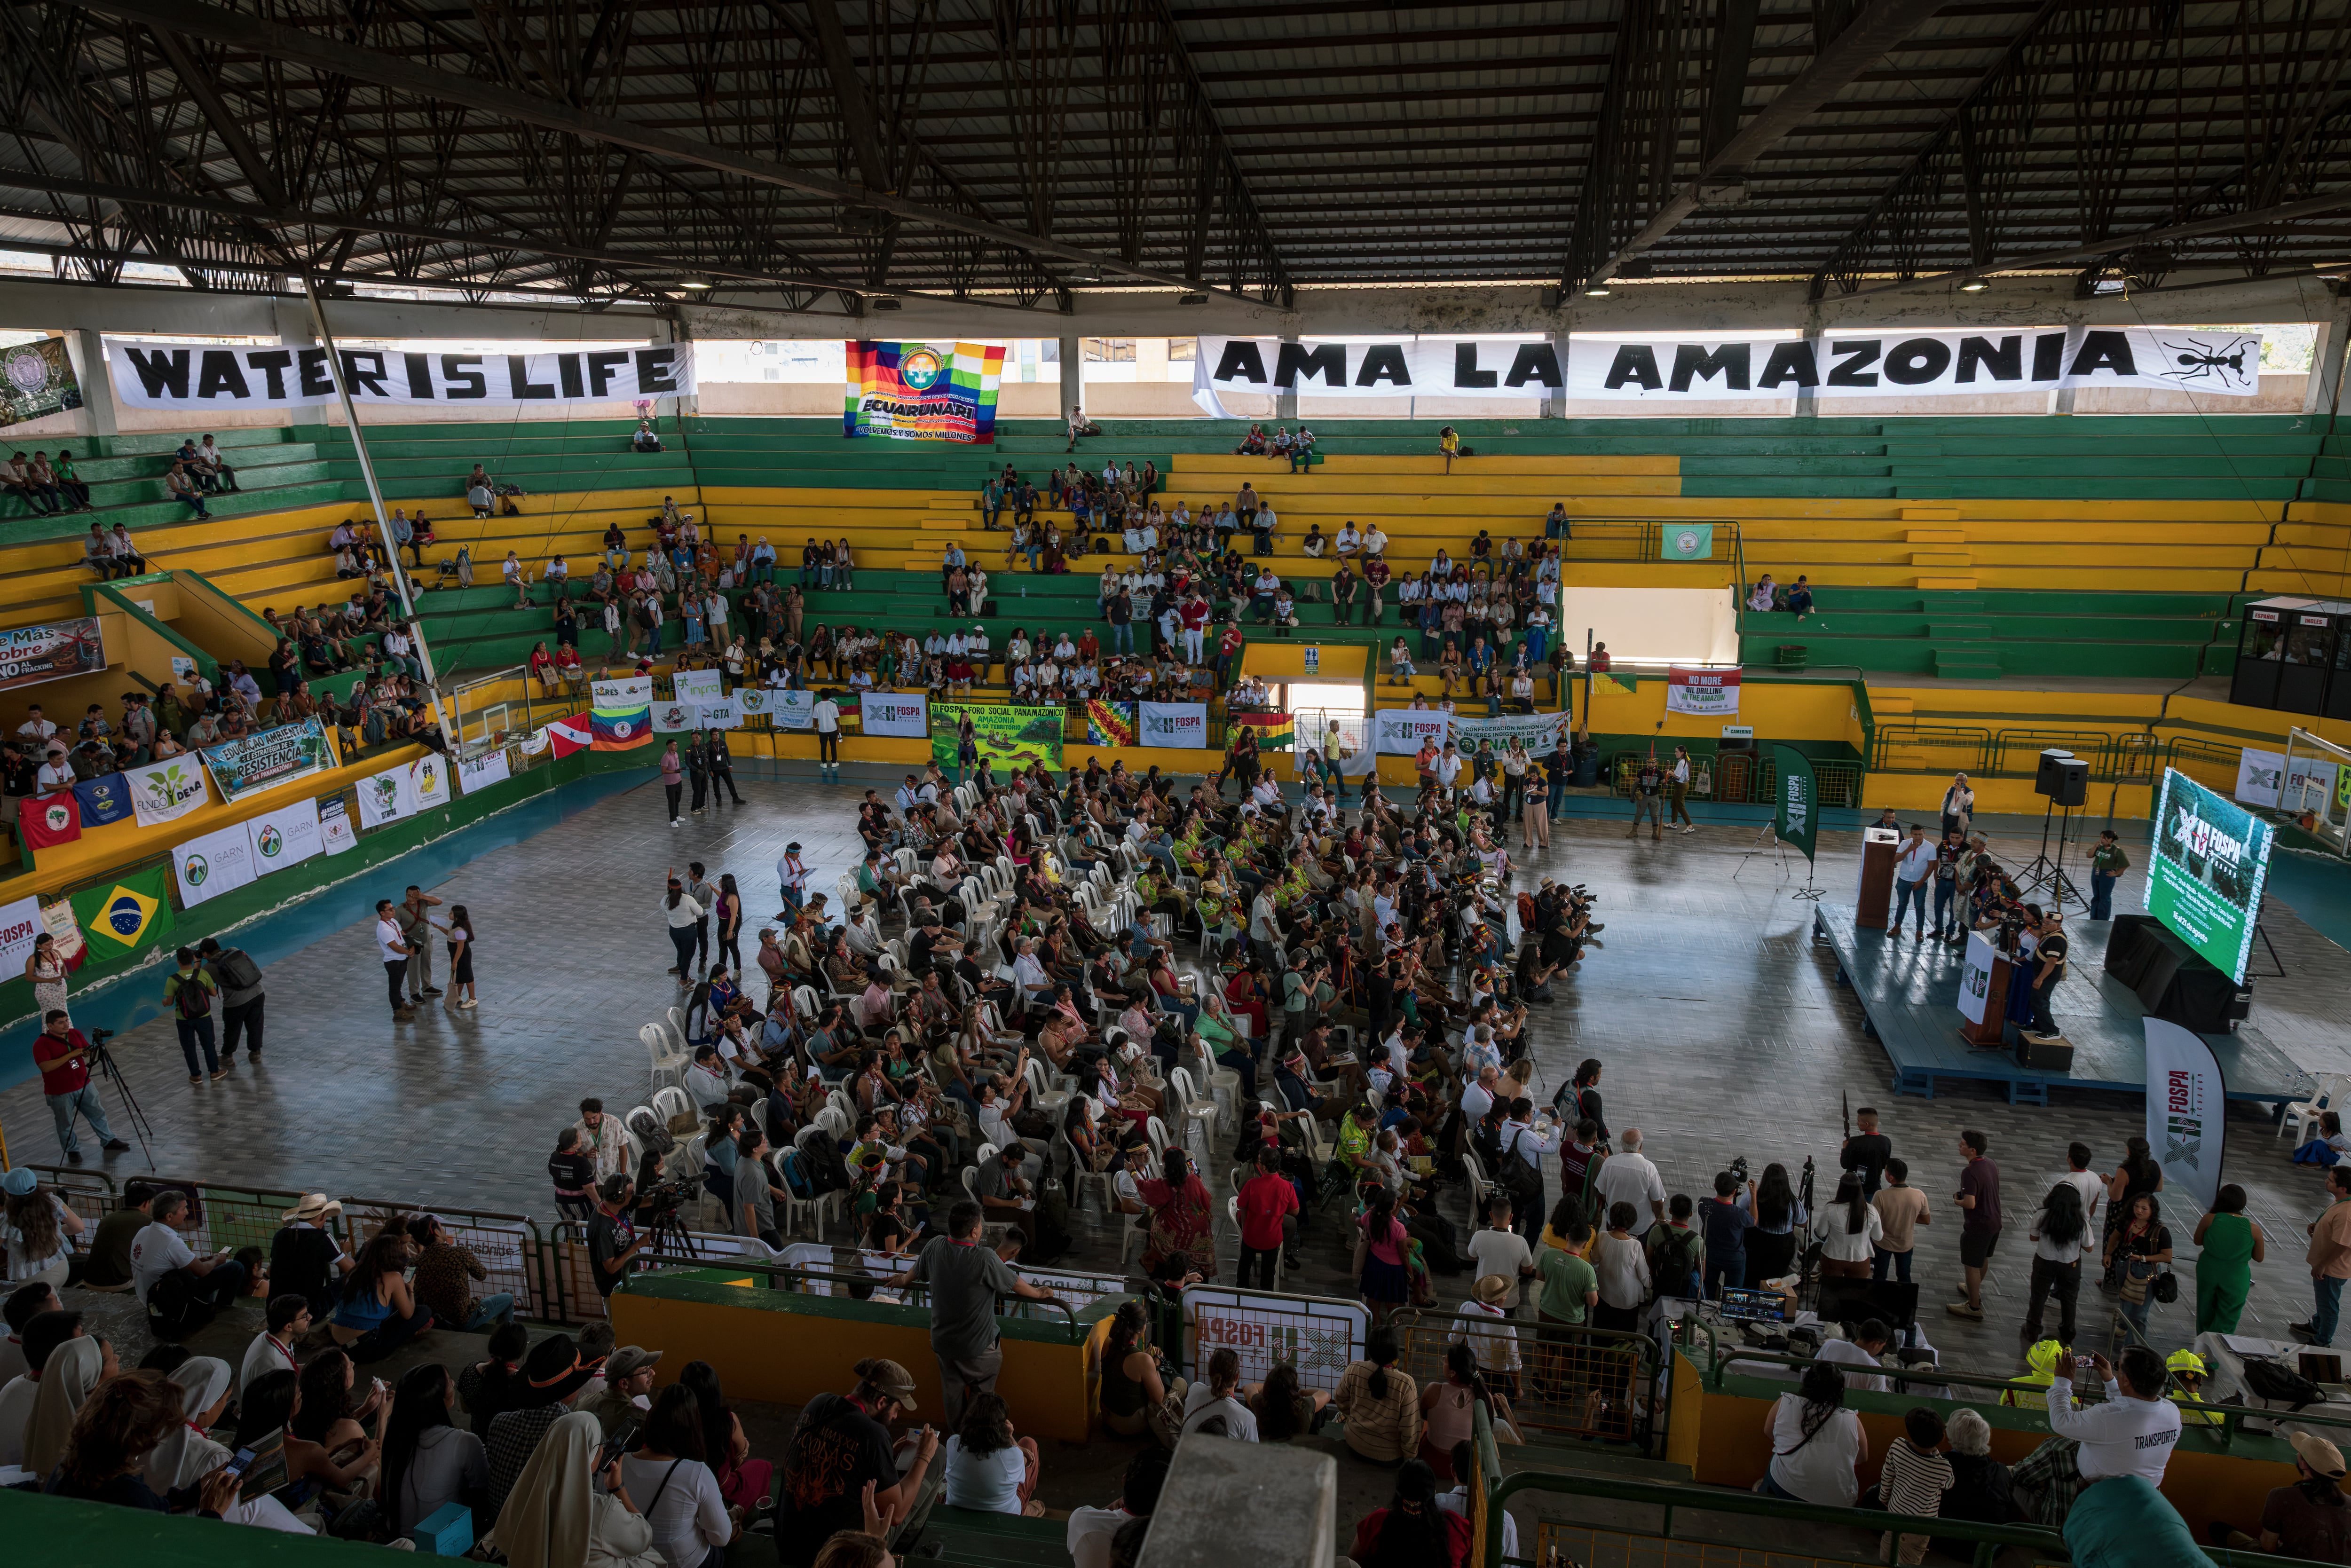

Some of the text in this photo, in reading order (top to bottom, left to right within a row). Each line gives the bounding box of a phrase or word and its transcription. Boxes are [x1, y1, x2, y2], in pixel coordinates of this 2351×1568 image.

[896, 351, 909, 370] ECUADOR
[1213, 331, 2138, 392] AMA LA AMAZONIA
[124, 347, 677, 399] WATER IS LIFE
[862, 399, 975, 421] ECUARUNARI
[905, 430, 932, 439] SOMOS
[13, 628, 55, 644] Más
[0, 645, 42, 661] obre
[21, 662, 53, 674] FRACKING
[677, 676, 689, 690] gt
[1688, 675, 1722, 685] NO MORE
[690, 684, 719, 697] infra
[713, 709, 729, 719] GTA
[897, 706, 920, 716] FOSPA
[978, 714, 1015, 723] AMAZÔNIA
[989, 707, 1011, 716] SOCIAL
[1014, 707, 1064, 717] PANAMAZÔNICO
[1176, 716, 1200, 727] FOSPA
[1414, 722, 1441, 733] FOSPA
[222, 724, 309, 761] EDUCAÇÃO AMBIENTAL
[236, 746, 302, 779] RESISTÊNCIA
[260, 763, 292, 779] PANAMAZÔNIA
[1788, 775, 1799, 802] FOSPA
[137, 797, 167, 811] FUNDO
[287, 819, 313, 837] GARN
[214, 844, 244, 863] GARN
[2210, 827, 2241, 864] FOSPA
[2173, 911, 2178, 920] 16
[2192, 926, 2208, 943] agosto
[2169, 1070, 2189, 1114] FOSPA
[2134, 1429, 2177, 1450] TRANSPORTE
